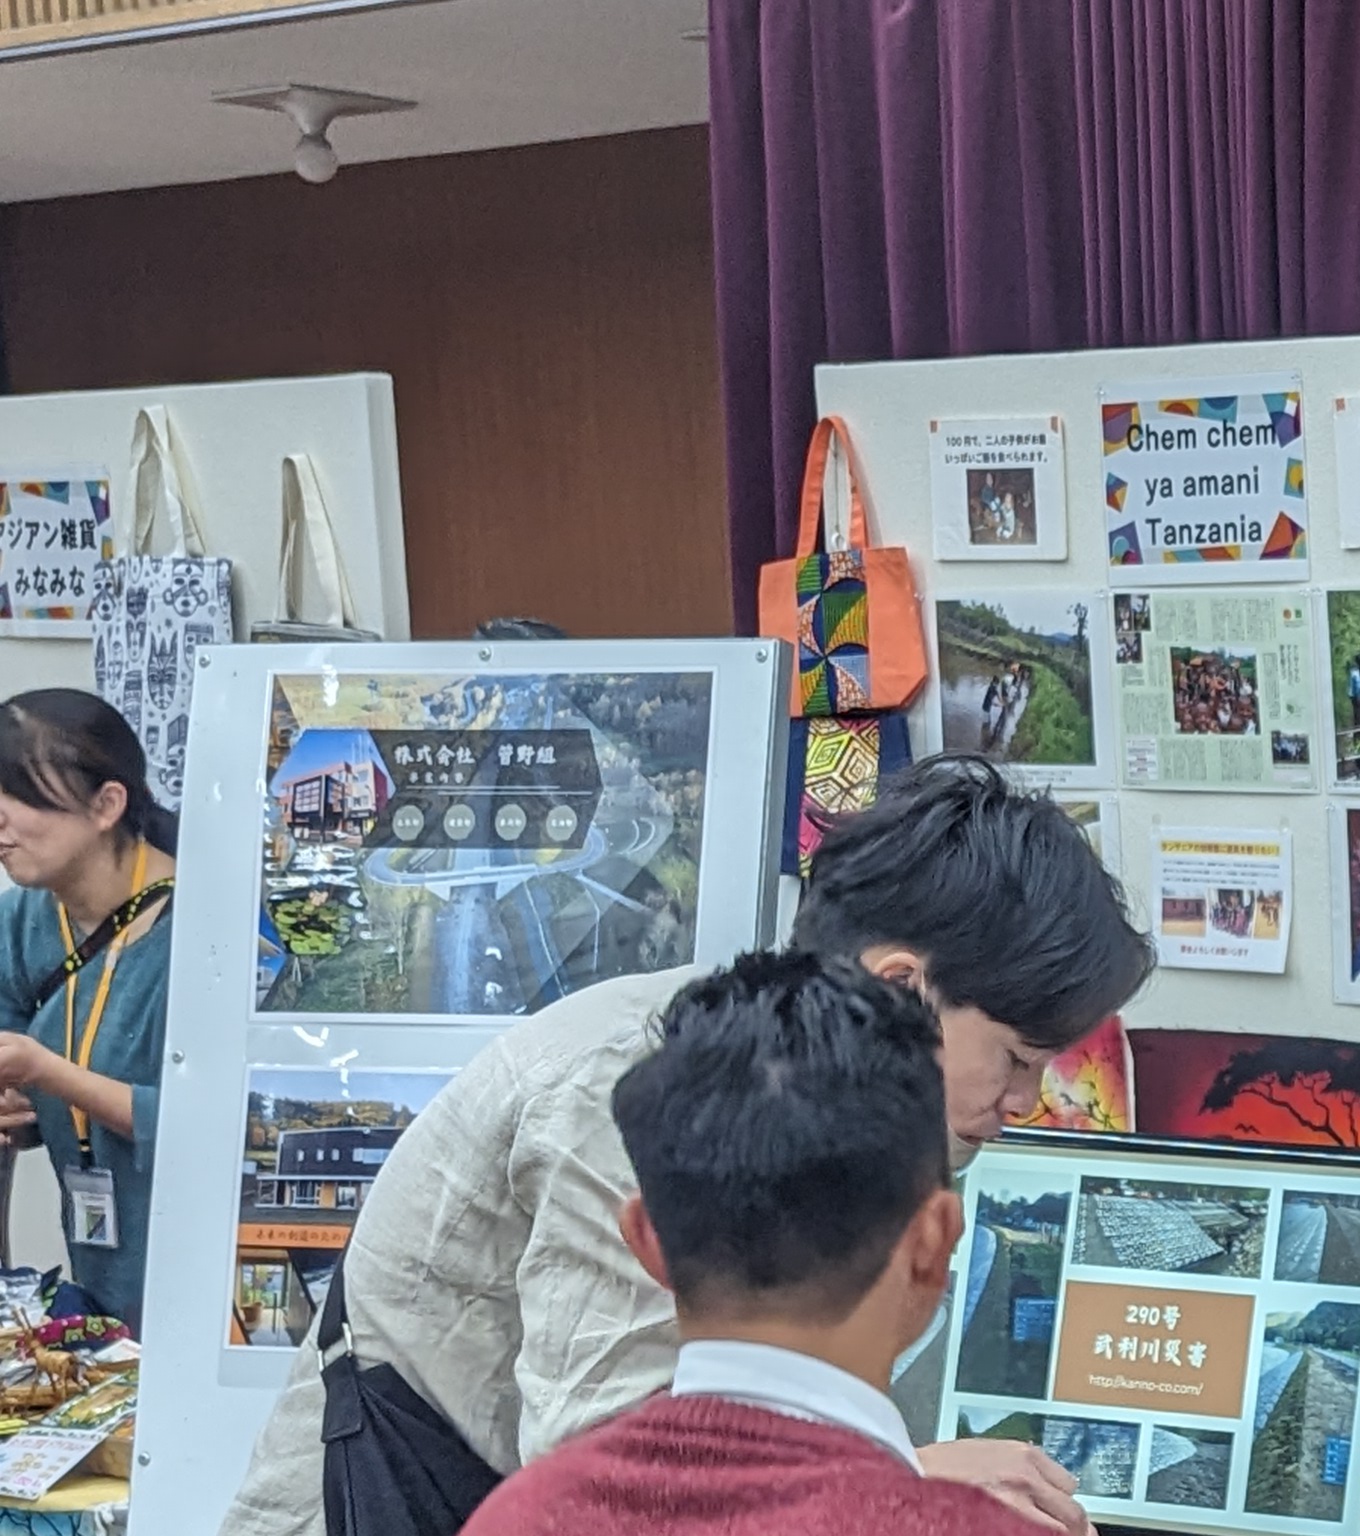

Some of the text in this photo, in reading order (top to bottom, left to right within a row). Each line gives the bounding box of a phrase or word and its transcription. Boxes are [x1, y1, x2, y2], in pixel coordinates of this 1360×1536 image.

[1127, 419, 1276, 451] Chem chem
[1145, 466, 1259, 506] ya amani
[1145, 514, 1262, 546] Tanzania
[15, 566, 85, 597] みなみな
[1125, 1305, 1181, 1331] 290号
[1094, 1334, 1207, 1368] 武利川災害
